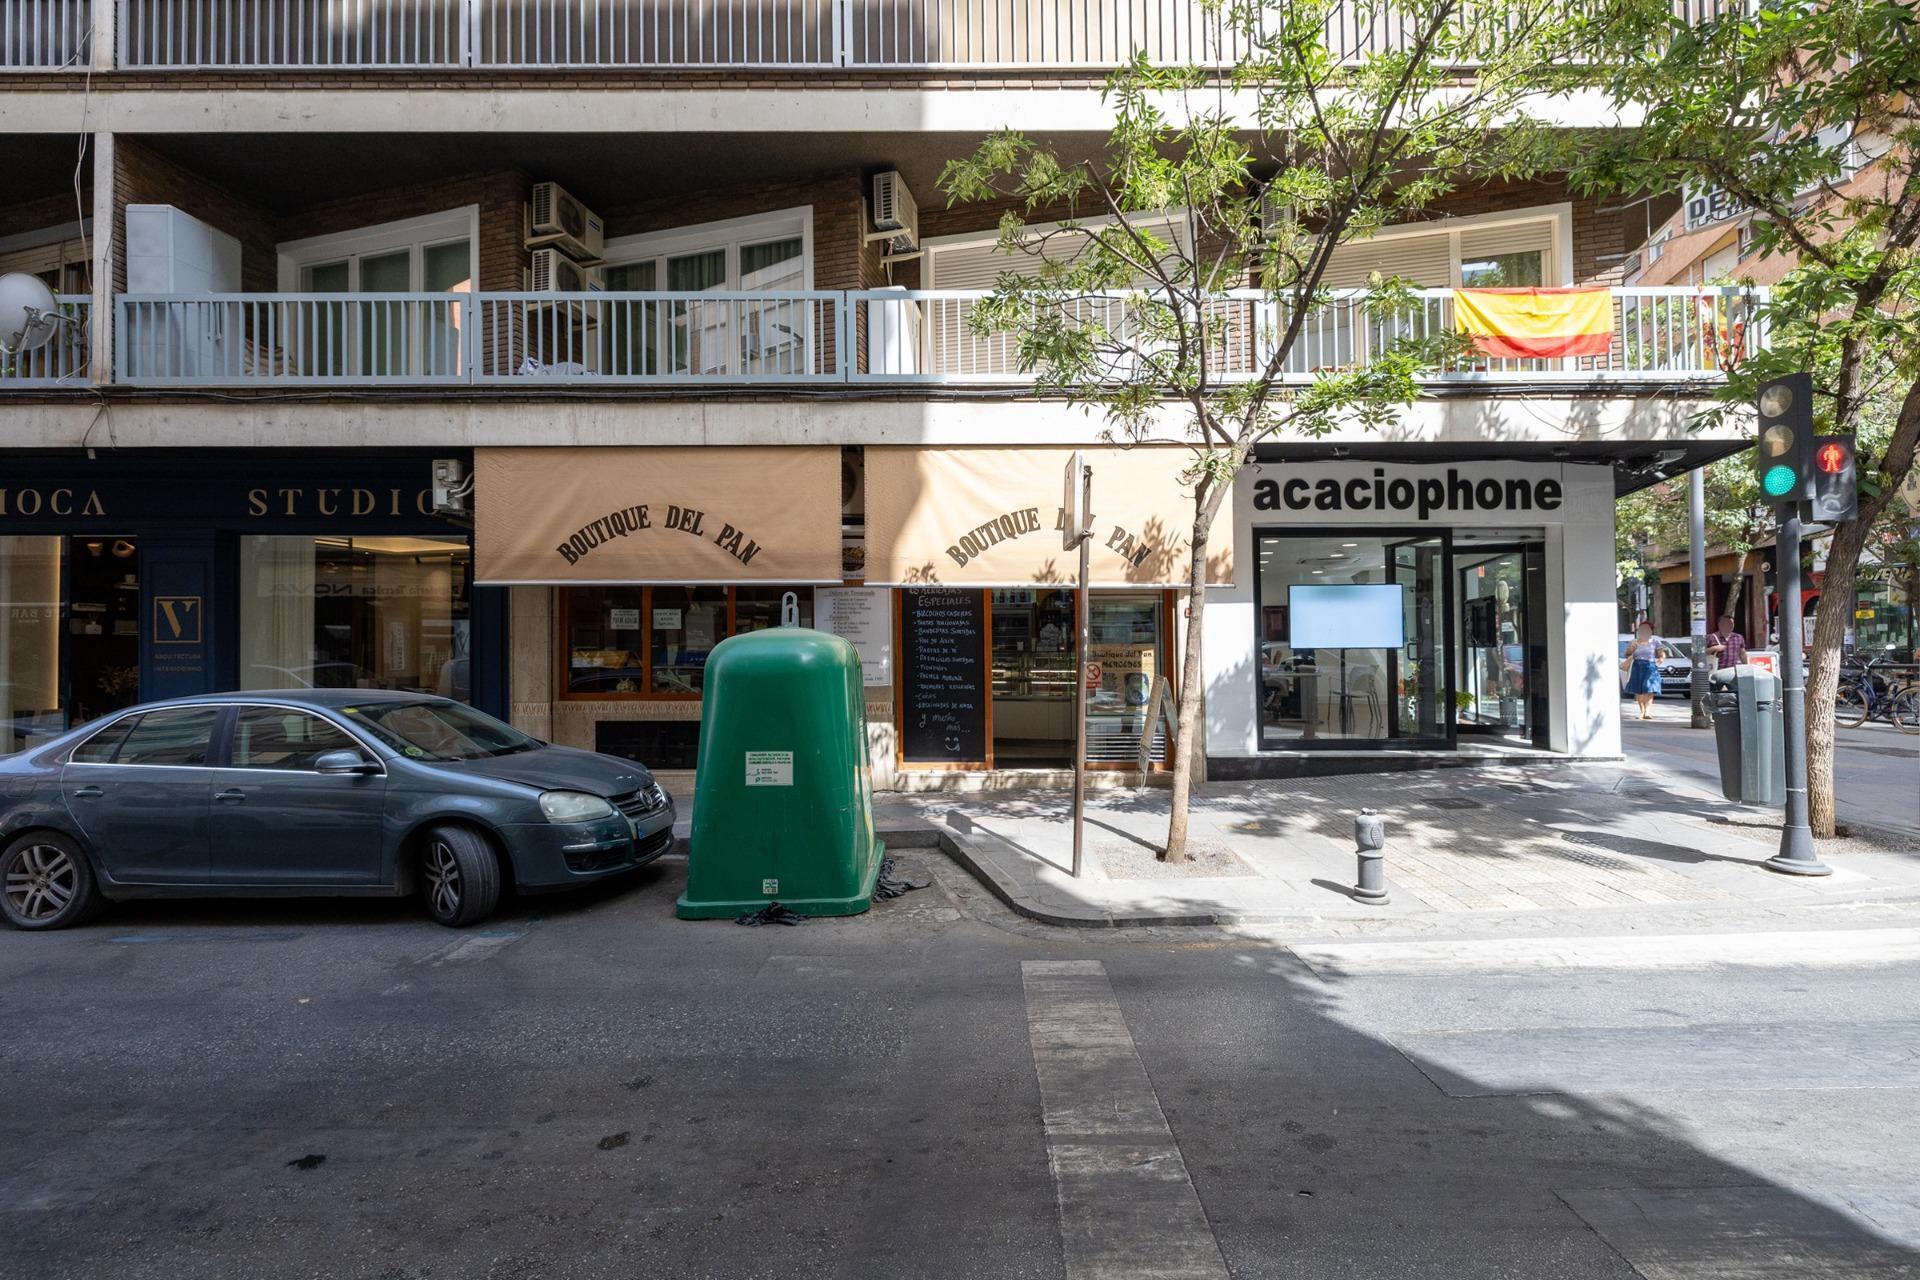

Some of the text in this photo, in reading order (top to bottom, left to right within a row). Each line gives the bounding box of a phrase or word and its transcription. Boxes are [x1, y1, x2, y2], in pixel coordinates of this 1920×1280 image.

[248, 488, 440, 516] STUDIO
[1253, 468, 1562, 520] acaciophone
[555, 504, 762, 566] BOUTIQUE DEL PAN
[945, 506, 1153, 568] BOUTIQUE DL PAN
[158, 601, 197, 639] V
[918, 596, 971, 608] ESPECIALES
